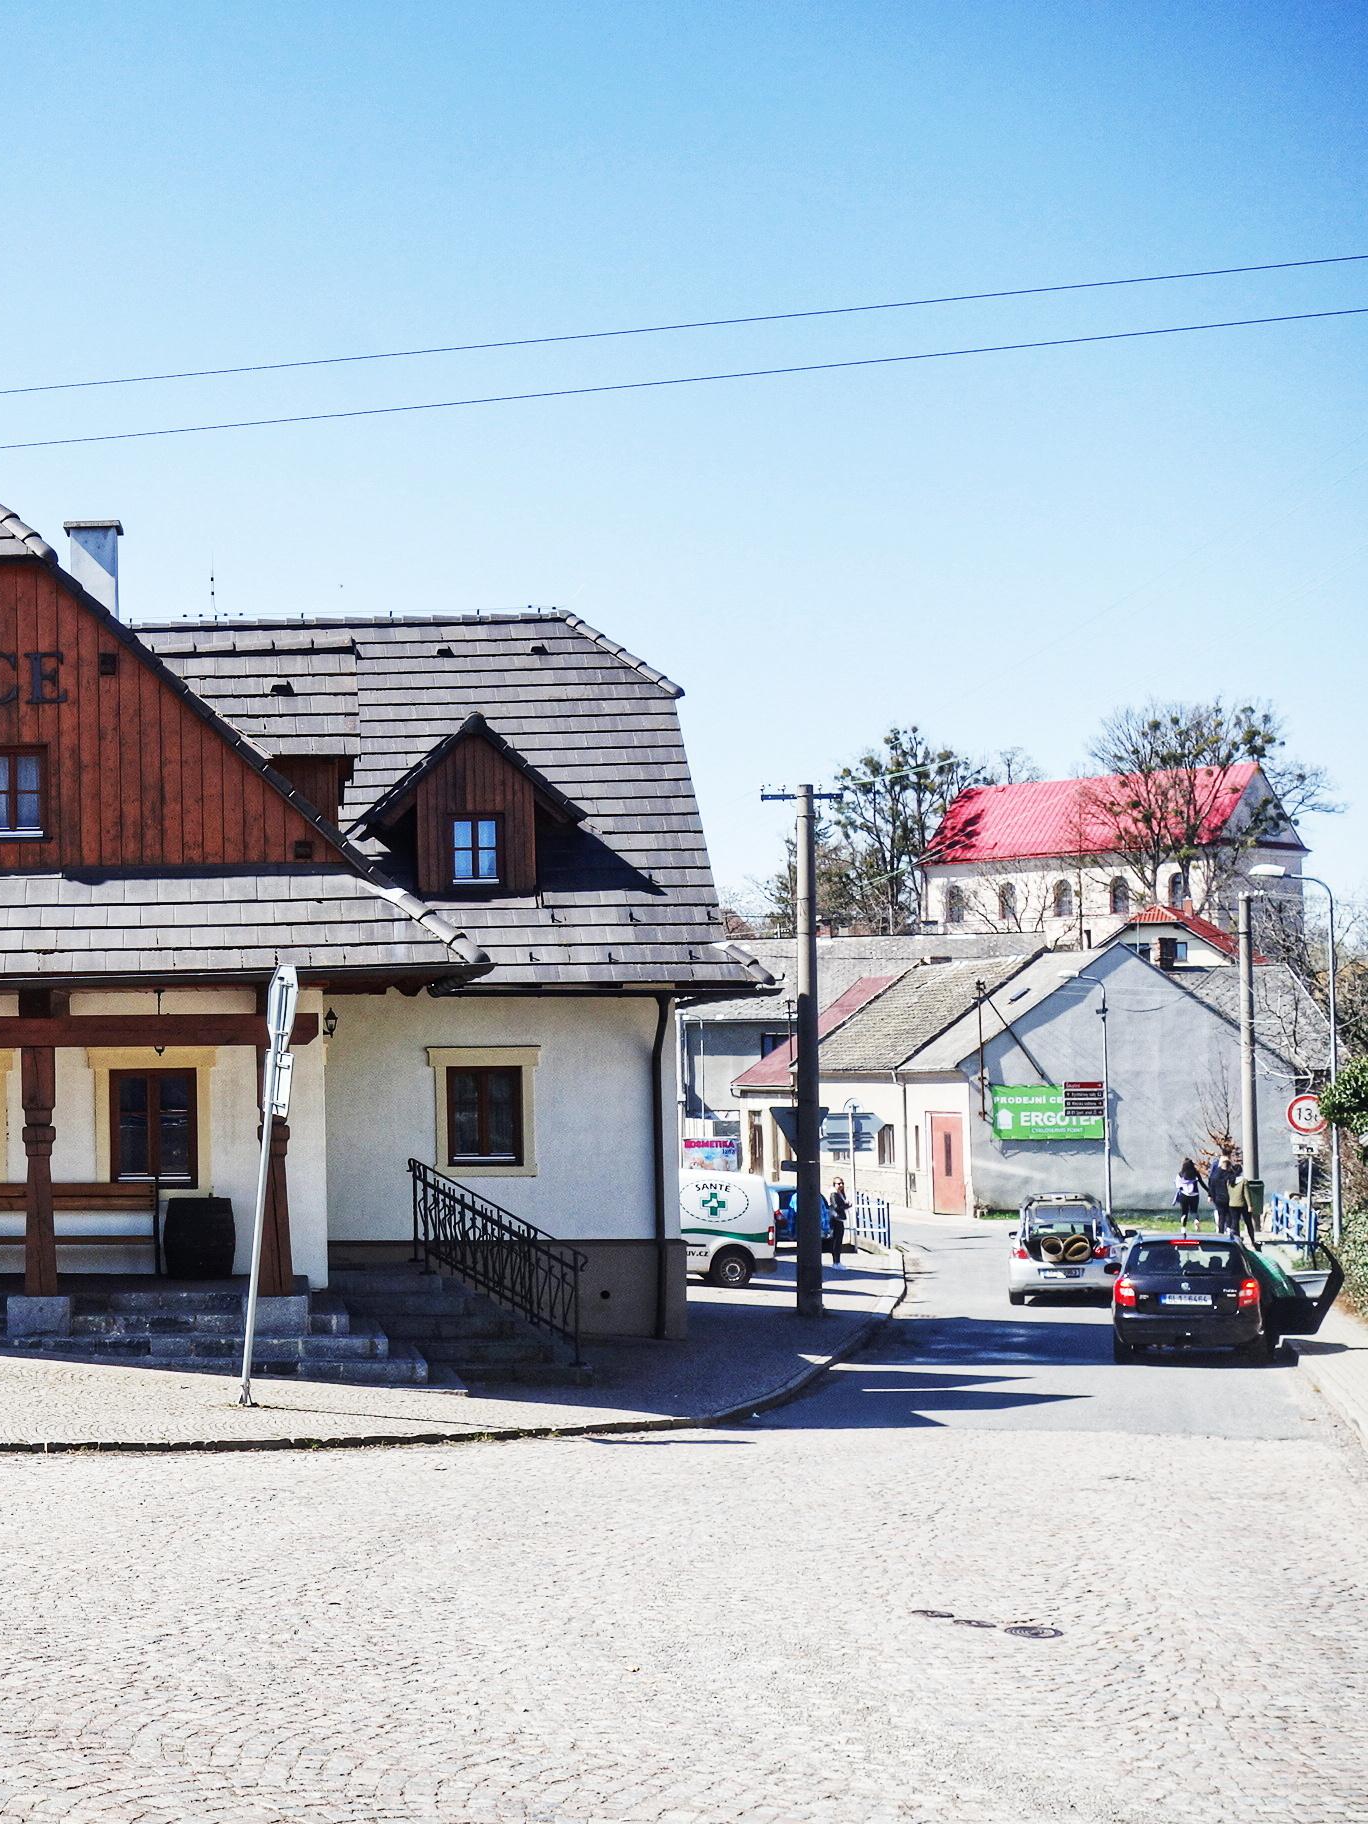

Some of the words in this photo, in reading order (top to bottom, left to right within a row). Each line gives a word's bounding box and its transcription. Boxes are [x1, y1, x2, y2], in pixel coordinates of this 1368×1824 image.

[993, 1095, 1047, 1104] PRODEJNÍ
[1020, 1111, 1102, 1126] ERGOTEP
[684, 1140, 735, 1149] KOSMETIKA
